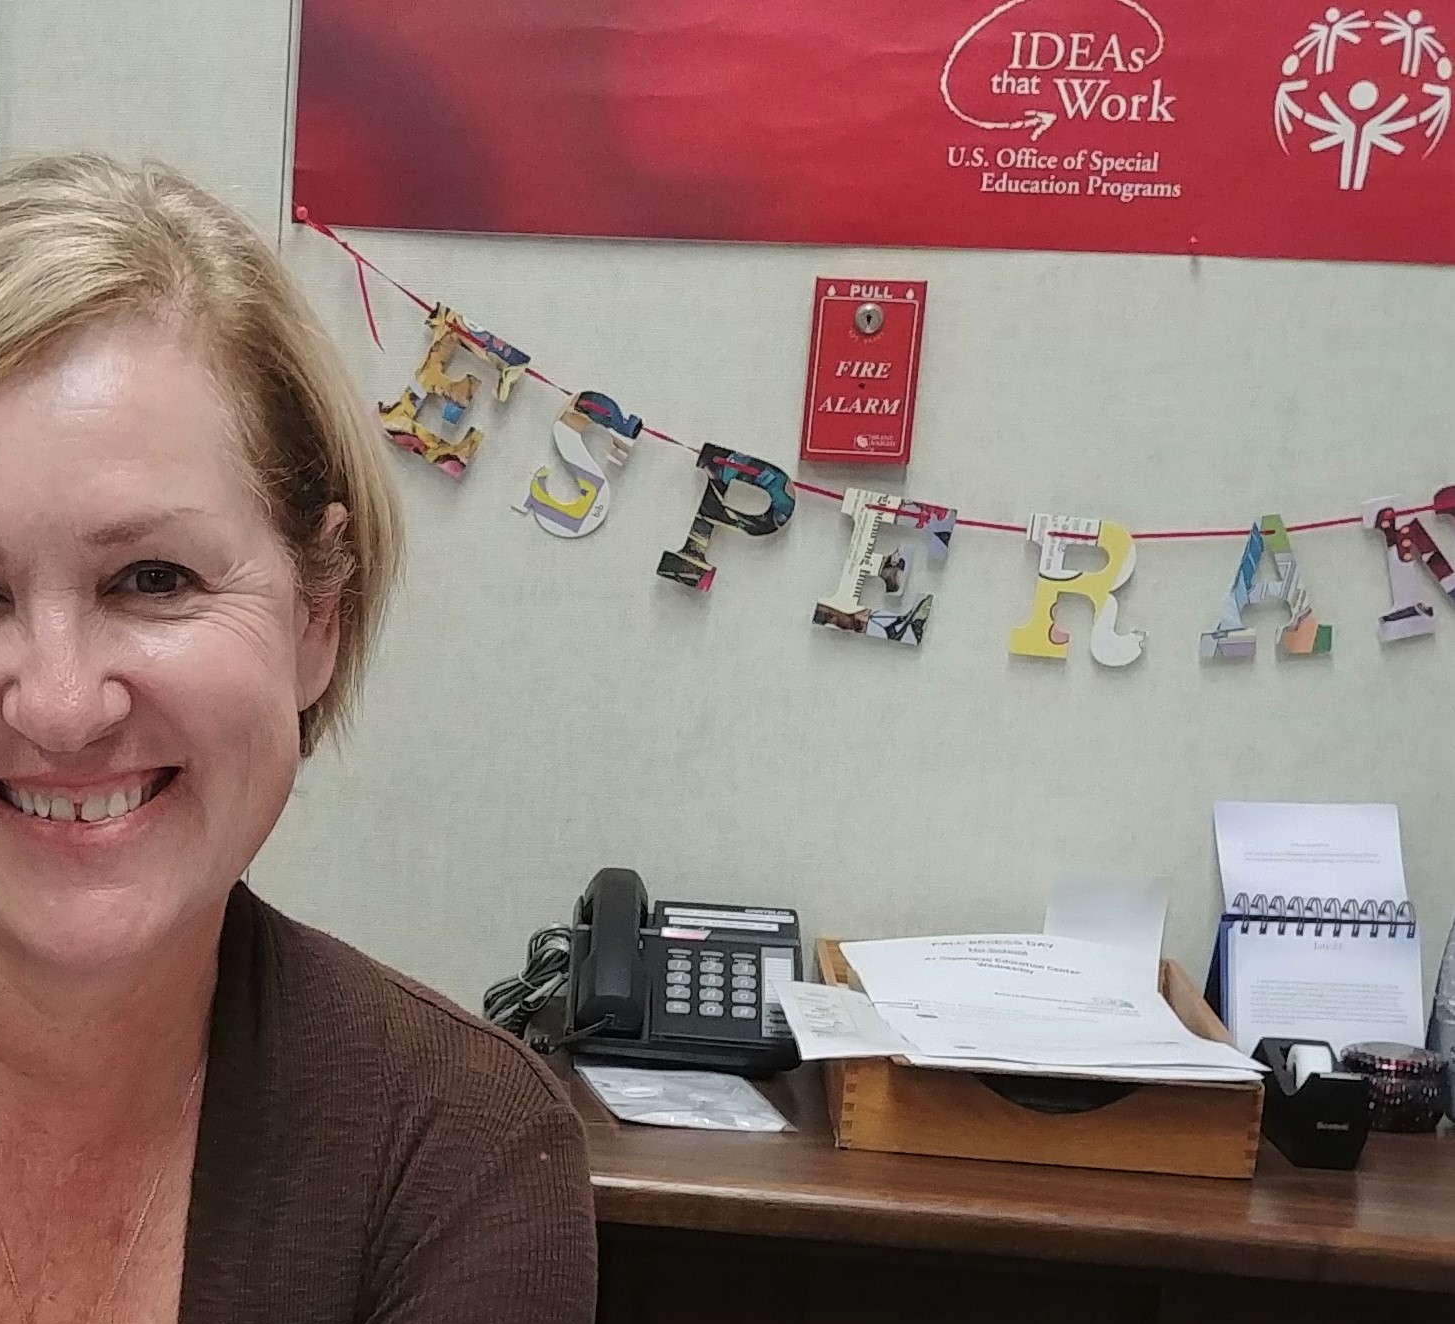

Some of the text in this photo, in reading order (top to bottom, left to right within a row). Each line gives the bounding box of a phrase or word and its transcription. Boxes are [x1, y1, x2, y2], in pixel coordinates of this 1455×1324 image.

[1007, 31, 1146, 73] IDEAs
[991, 70, 1176, 122] that Work
[947, 146, 1159, 177] U.S. Office of Special
[979, 172, 1181, 203] Education Programs
[849, 284, 894, 299] PULL
[834, 361, 892, 379] FIRE
[817, 396, 901, 415] ALARM
